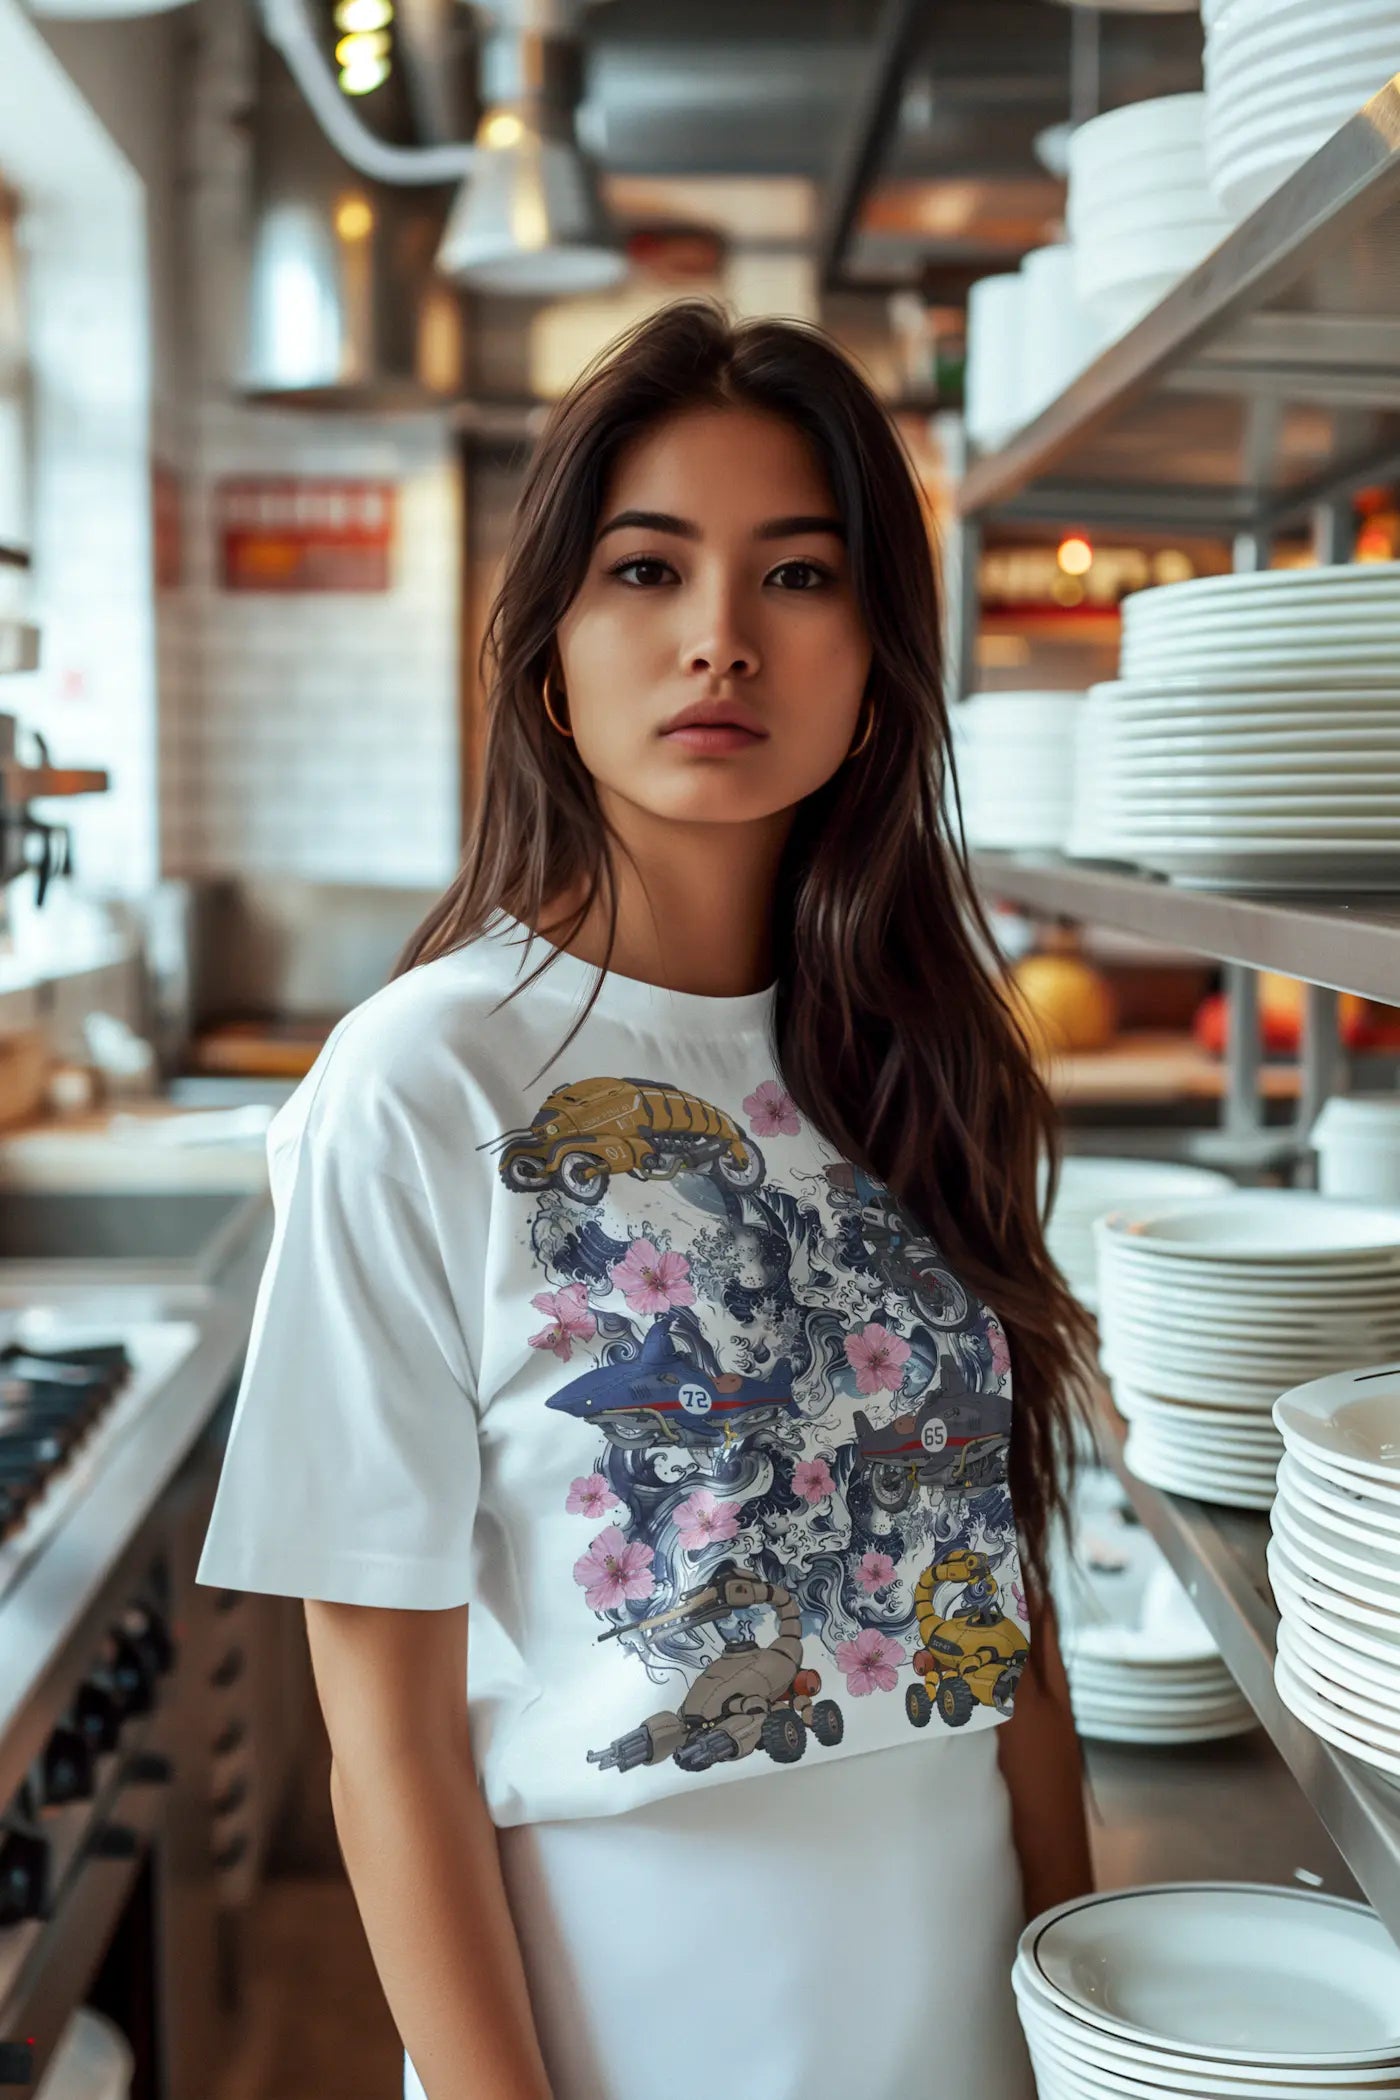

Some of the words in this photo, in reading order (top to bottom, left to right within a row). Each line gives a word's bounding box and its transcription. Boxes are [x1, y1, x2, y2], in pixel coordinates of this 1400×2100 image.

[605, 1145, 627, 1160] 01
[682, 1390, 709, 1409] 72
[924, 1426, 945, 1446] 65
